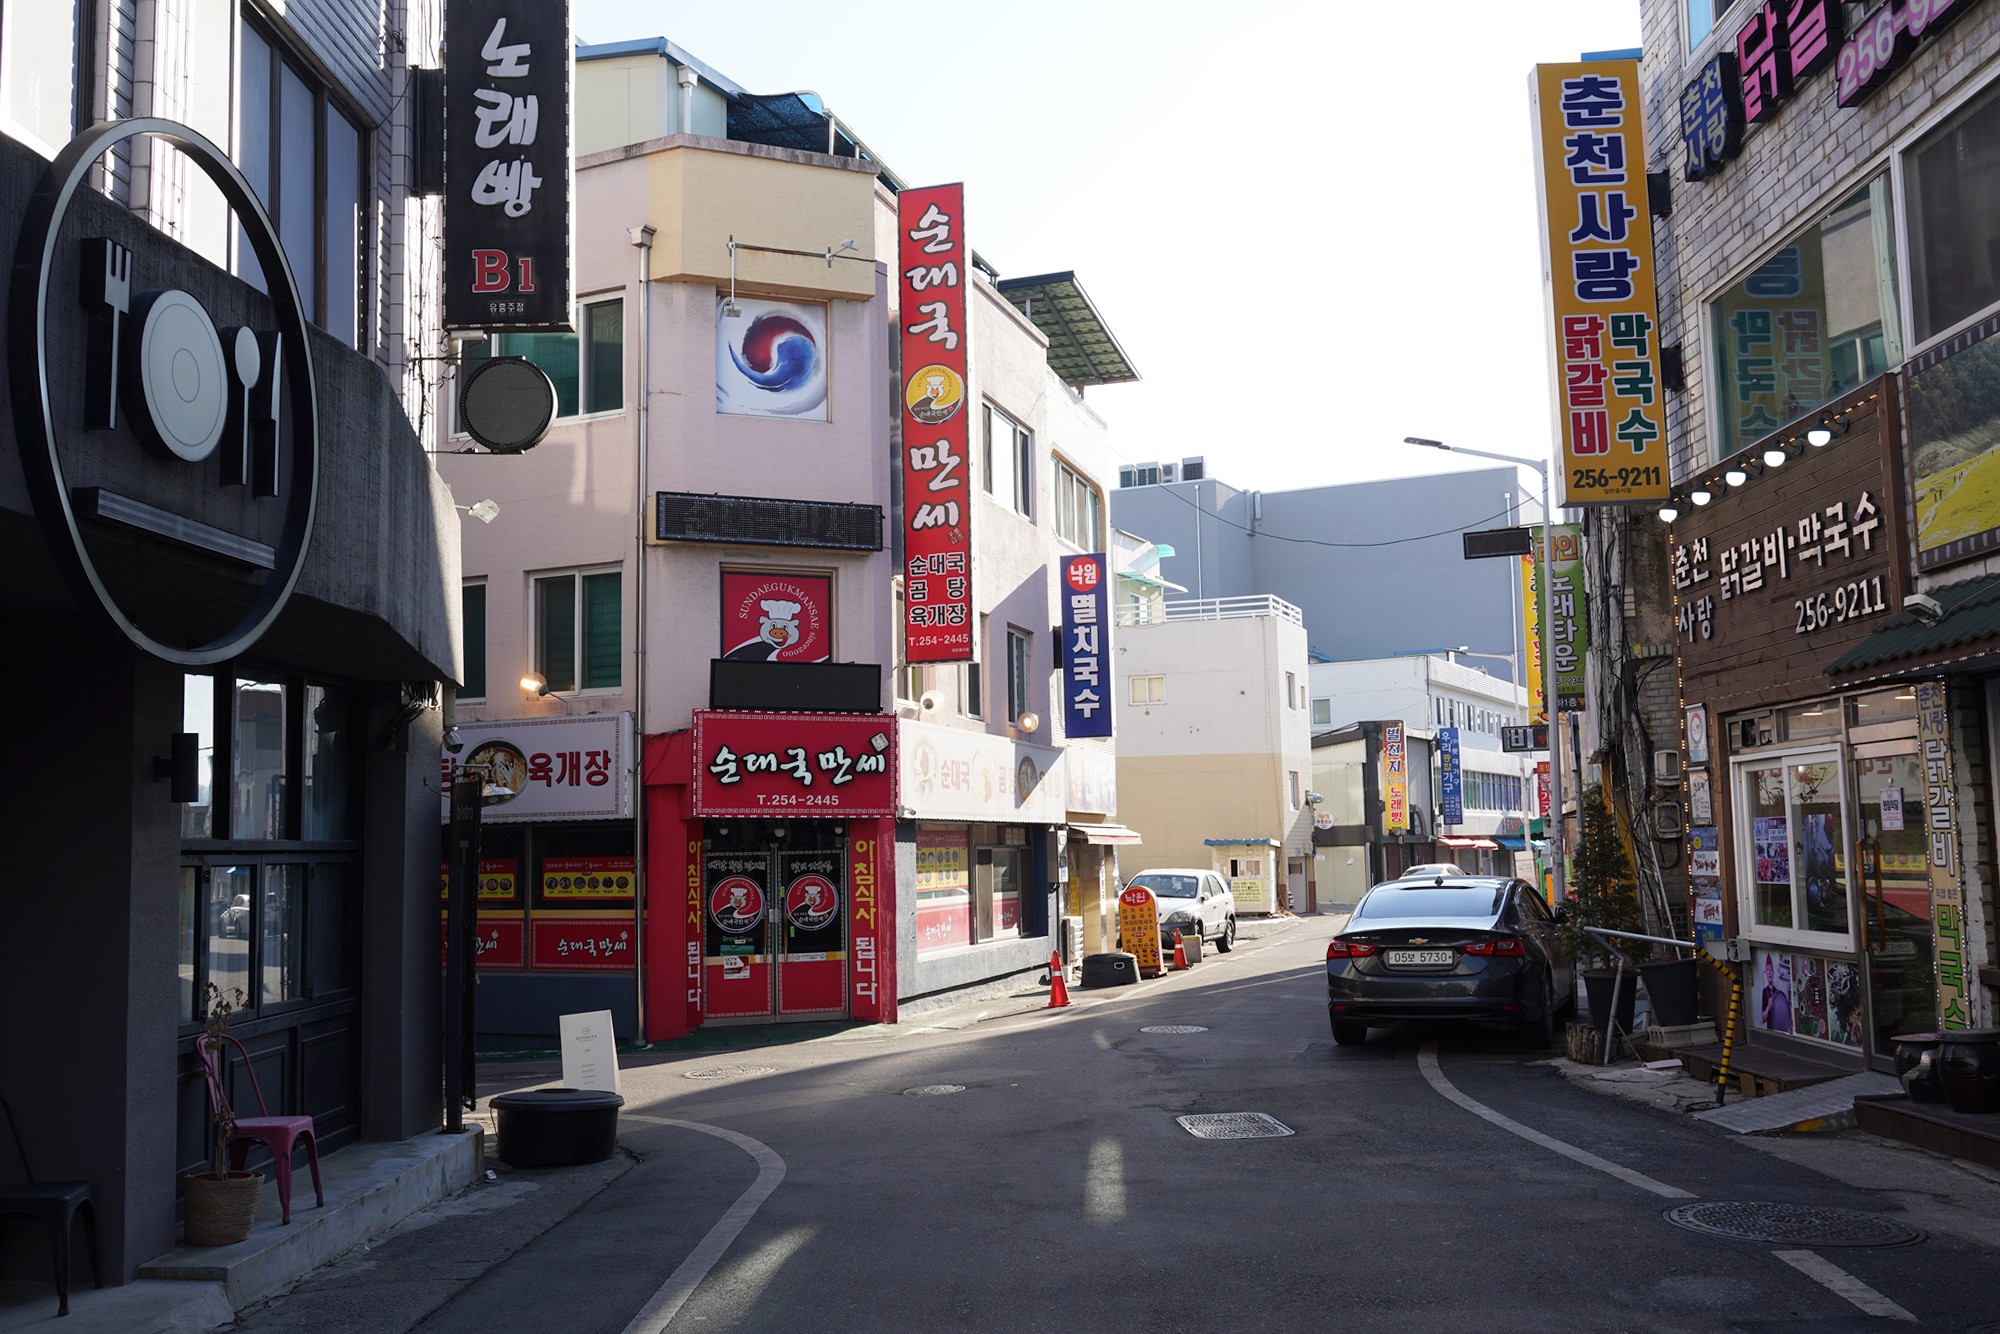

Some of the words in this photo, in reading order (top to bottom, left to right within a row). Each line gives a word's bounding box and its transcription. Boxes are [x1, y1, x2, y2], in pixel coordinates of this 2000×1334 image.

[471, 18, 542, 217] 노래빵
[1683, 58, 1723, 137] 춘천
[1687, 108, 1727, 174] 사랑
[1561, 76, 1639, 300] 춘천사랑
[905, 203, 958, 350] 순대국
[489, 302, 524, 312] 유흥주점
[1562, 314, 1611, 456] 닭갈비
[1610, 313, 1659, 454] 막국수
[910, 439, 962, 530] 만세
[1573, 466, 1661, 489] 256-9211
[909, 552, 966, 575] 순대국
[1071, 564, 1096, 585] 낙원
[1674, 537, 1709, 589] 춘천
[738, 582, 820, 629] SUNDAEGUKMANSAE
[909, 603, 966, 627] 육개장
[1678, 595, 1713, 642] 사랑
[1795, 575, 1885, 634] 256-9211
[908, 634, 969, 647] T.254-2445
[1071, 594, 1099, 718] 멸치국수
[1919, 684, 1945, 710] 춘천
[1922, 711, 1945, 736] 사랑
[528, 750, 612, 787] 육개장
[941, 760, 970, 792] 순대국
[757, 795, 839, 806] T.254-2445
[1925, 739, 1955, 876] 닭갈비
[688, 840, 702, 934] 아침식사
[855, 840, 876, 929] 아침식사
[1125, 892, 1146, 904] 낙원
[687, 940, 701, 1011] 됩니다
[856, 937, 877, 1005] 됩니다
[1420, 952, 1448, 963] 5730
[1937, 904, 1966, 1030] 막국수
